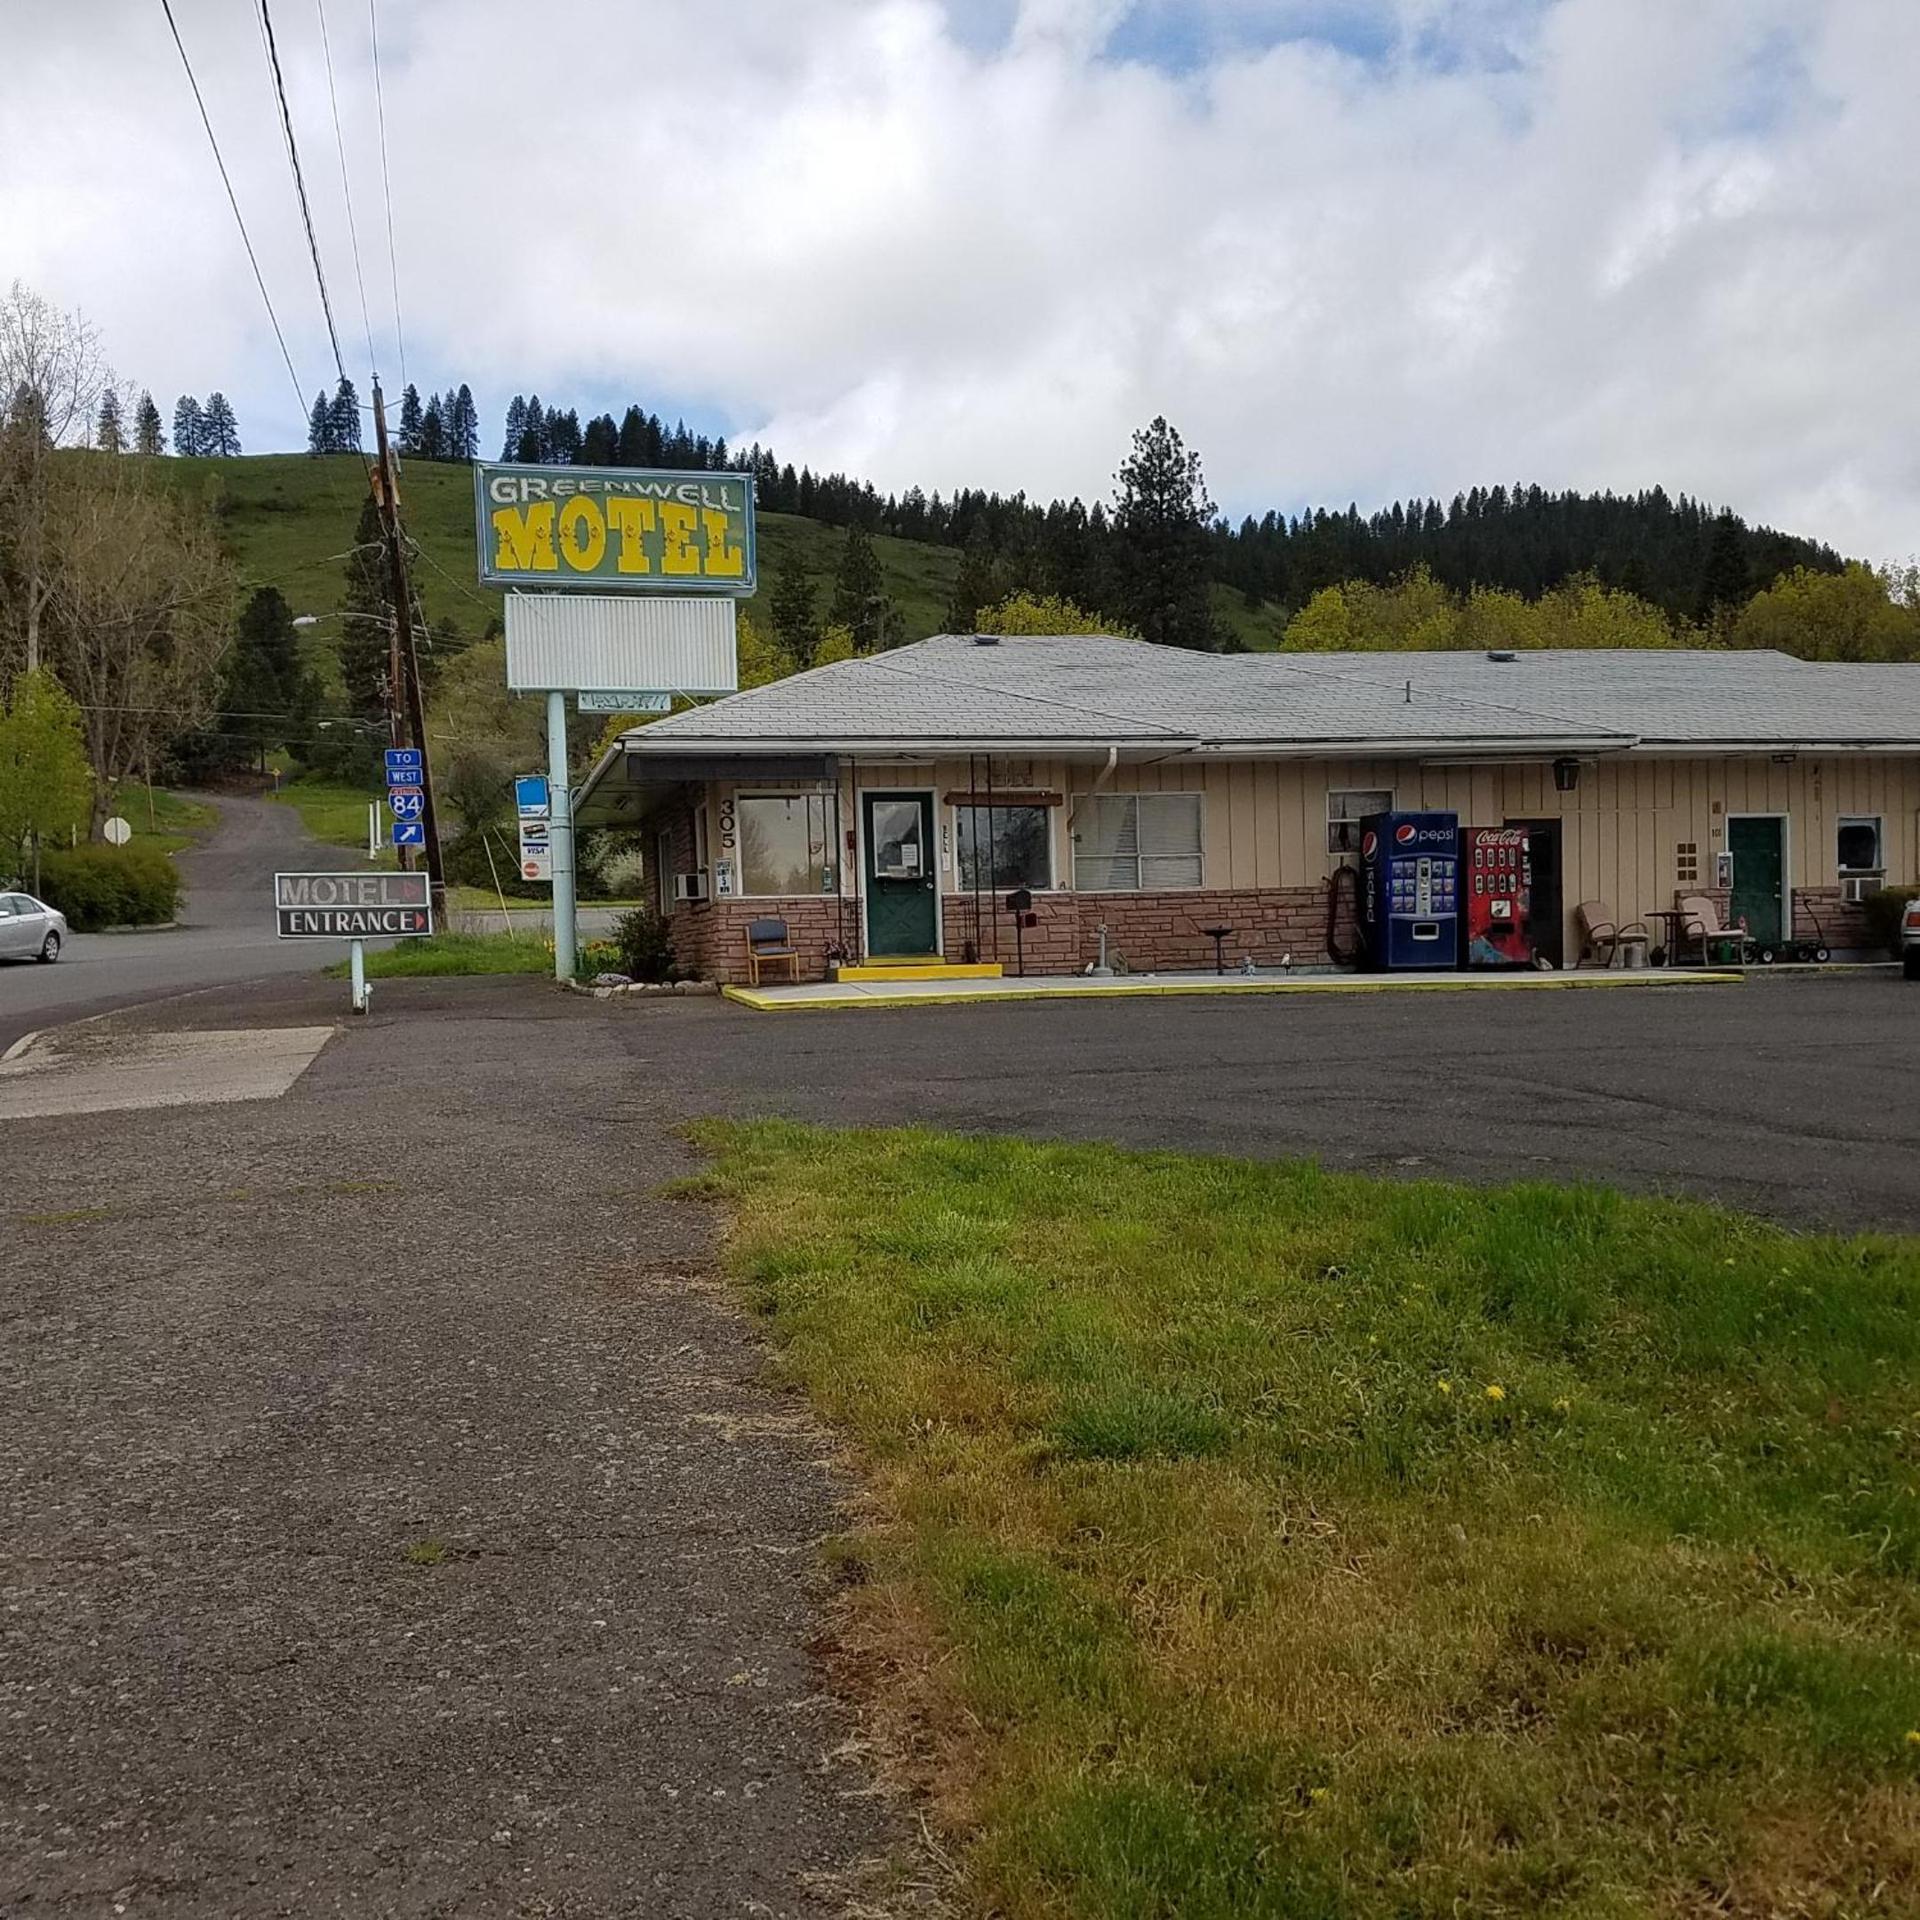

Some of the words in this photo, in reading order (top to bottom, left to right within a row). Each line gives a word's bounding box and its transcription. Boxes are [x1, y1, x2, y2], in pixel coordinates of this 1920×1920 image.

[490, 476, 740, 512] GREENWELL
[492, 495, 743, 576] MOTEL
[394, 753, 411, 764] TO
[392, 771, 417, 783] WEST
[393, 795, 420, 814] 84
[719, 799, 735, 849] 305
[1418, 828, 1454, 843] pepsi
[526, 847, 545, 855] VISA
[280, 877, 402, 905] MOTEL
[1365, 866, 1376, 923] pepsi
[290, 911, 414, 933] ENTRANCE
